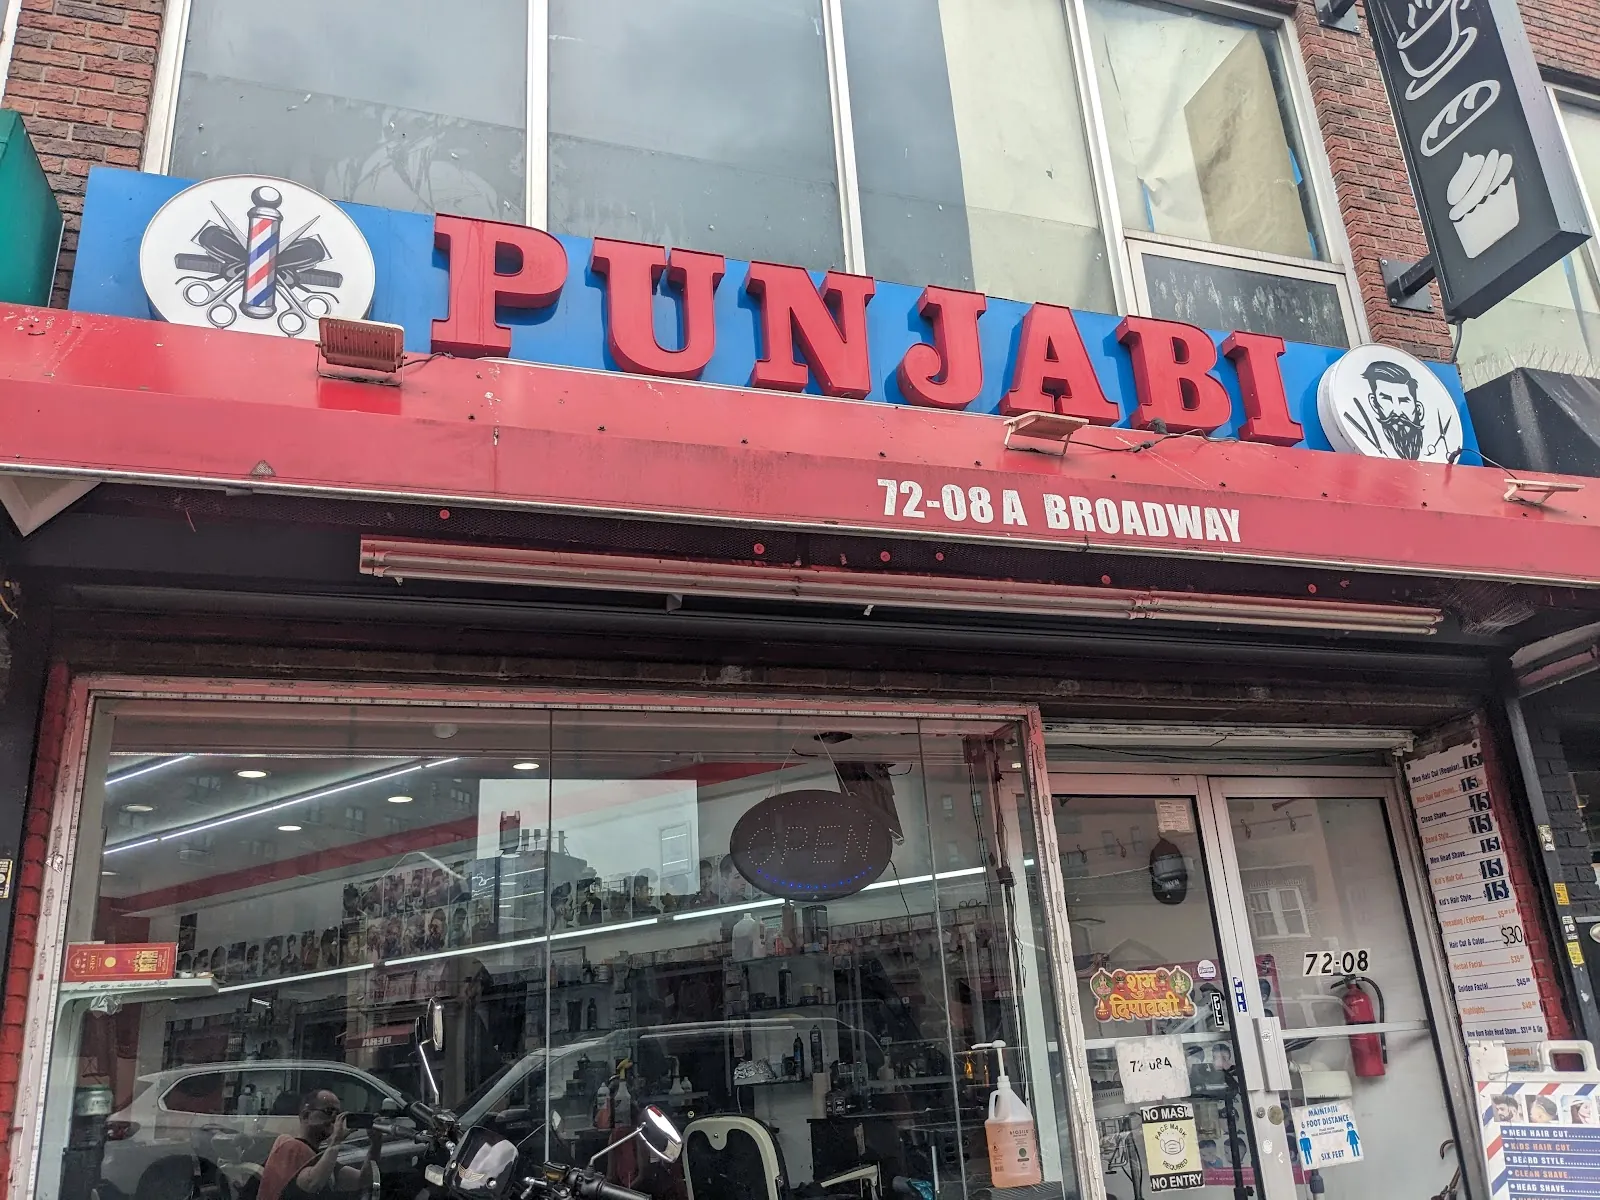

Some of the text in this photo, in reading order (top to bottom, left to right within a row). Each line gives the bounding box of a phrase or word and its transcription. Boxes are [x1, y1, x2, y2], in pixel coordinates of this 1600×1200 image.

[430, 212, 1306, 447] PUNJABI
[877, 478, 1241, 543] 72-08 A BROADWAY
[1464, 753, 1481, 769] 15
[1471, 792, 1490, 812] 15
[1471, 813, 1490, 834] 15
[747, 825, 873, 865] OPEN
[1480, 837, 1499, 853] 15
[1501, 925, 1523, 946] $30
[1305, 950, 1369, 975] 72-08
[1234, 978, 1246, 1012] PULL
[1212, 995, 1224, 1024] PULL
[1142, 1108, 1158, 1120] NO
[1301, 1114, 1350, 1129] 6 FOOT DISTANCE
[1155, 1123, 1187, 1140] FACE MASK
[1508, 1129, 1568, 1138] MEN HAIR CUT
[1320, 1149, 1344, 1160] SIX FEET
[1510, 1142, 1530, 1150] KIDS
[1533, 1143, 1552, 1151] HAIR
[1162, 1158, 1188, 1171] REQUIRED
[1512, 1156, 1565, 1165] BEARD STYLE
[1152, 1176, 1167, 1190] NO
[1170, 1173, 1202, 1188] ENTRY
[1514, 1169, 1568, 1179] CLEAN SHAVE
[1516, 1183, 1565, 1192] HEAD SHAVE
